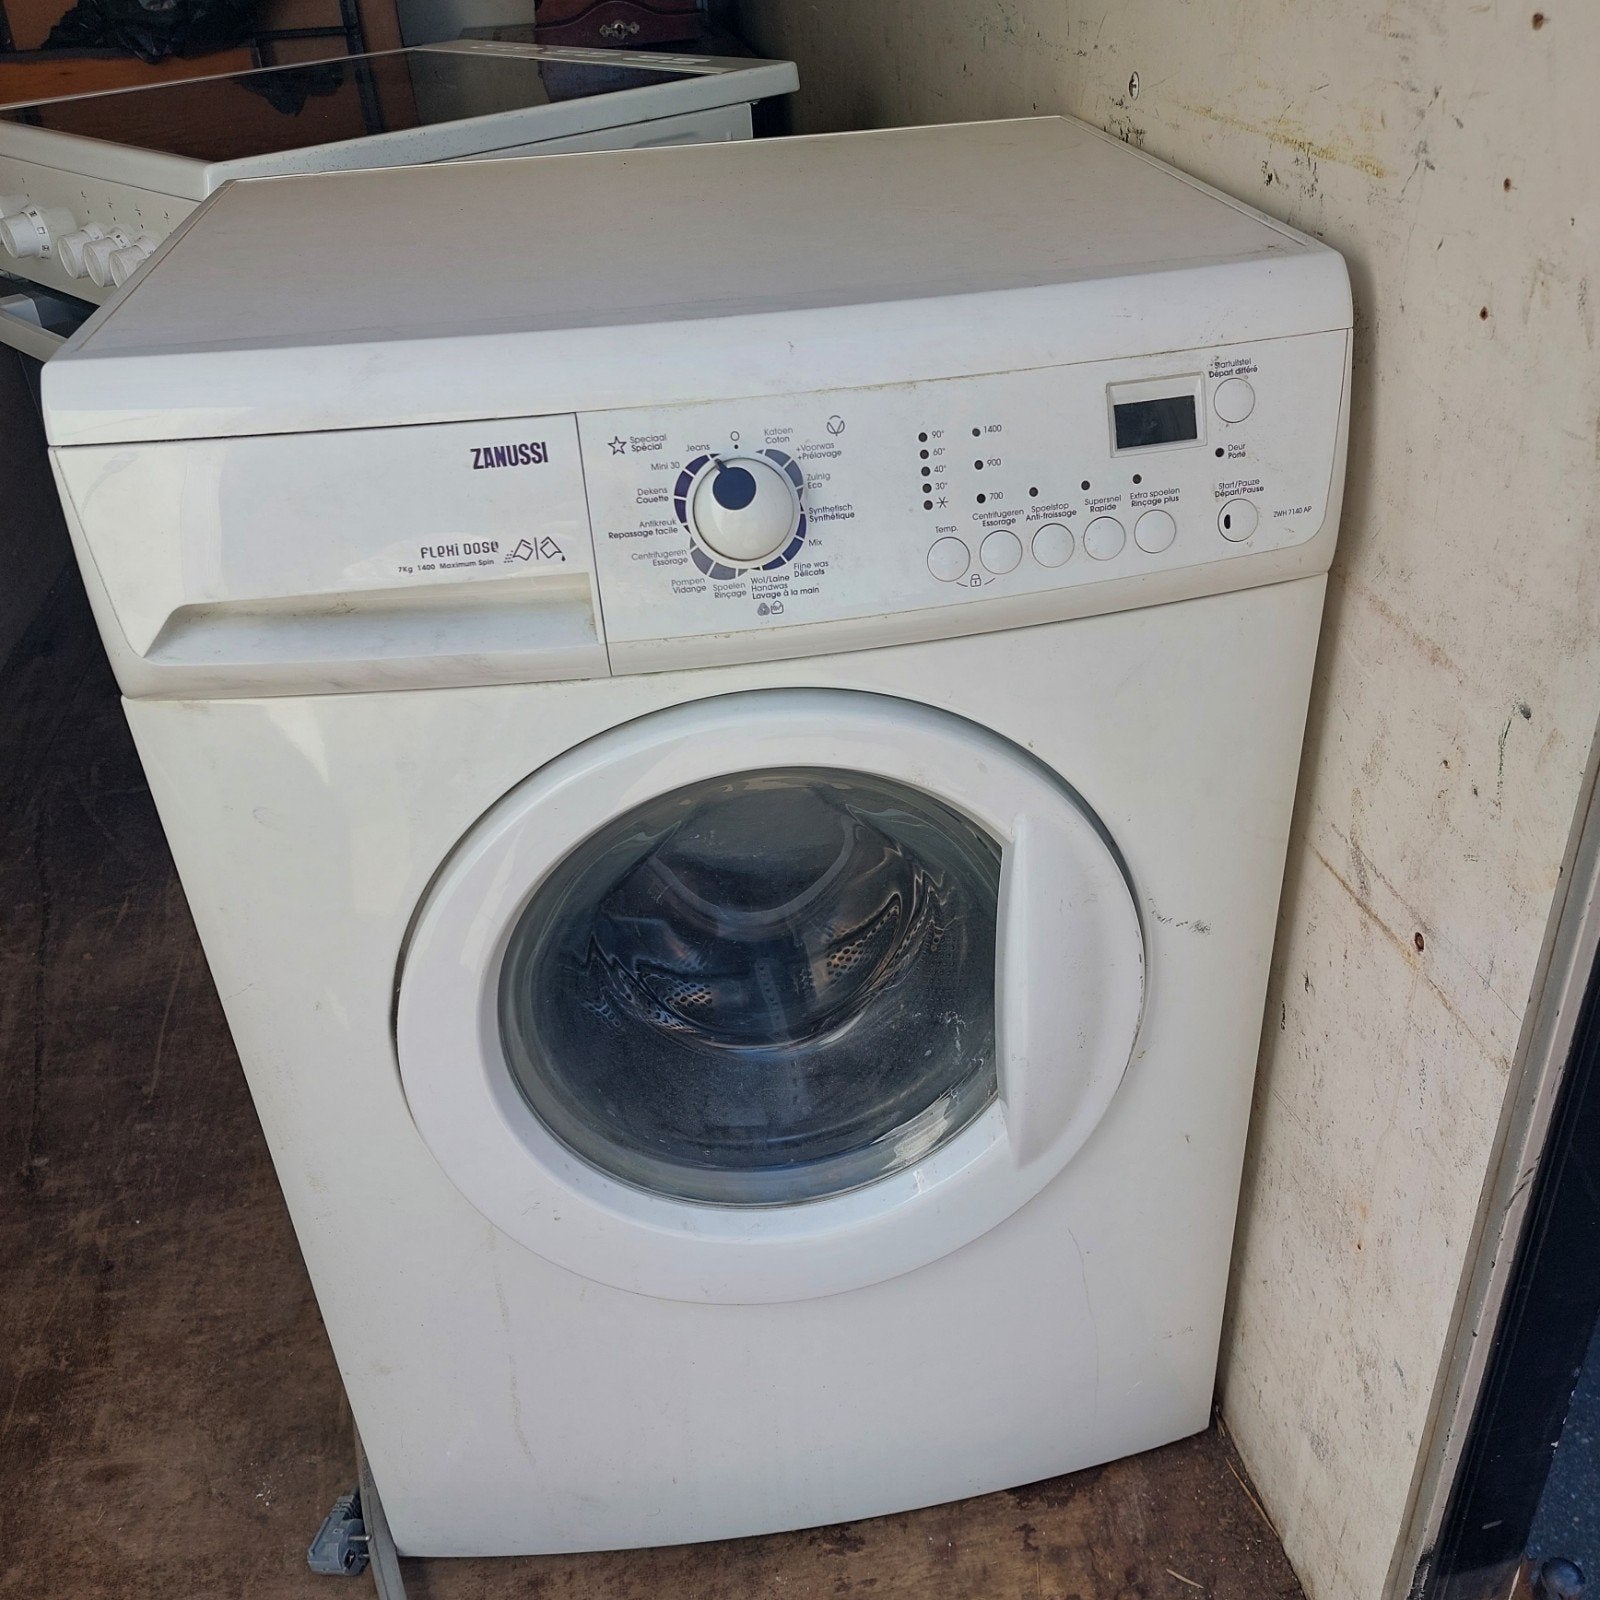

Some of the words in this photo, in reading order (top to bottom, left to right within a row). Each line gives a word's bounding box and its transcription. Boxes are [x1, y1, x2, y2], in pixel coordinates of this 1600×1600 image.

[1208, 368, 1233, 378] Départ
[1235, 366, 1258, 374] différé
[764, 427, 794, 436] Katoen
[984, 424, 1002, 434] 1400
[630, 434, 667, 444] Speciaal
[766, 436, 790, 444] Coton
[631, 443, 662, 452] Spécial
[686, 444, 710, 452] Jeans
[1228, 444, 1246, 452] Deur
[470, 442, 548, 470] ZANUSSI
[1228, 451, 1246, 459] Porte
[650, 462, 668, 471] Mini
[670, 462, 680, 470] 30
[986, 458, 1002, 466] 900
[806, 472, 830, 481] Zuinig
[1218, 478, 1260, 490] Start/Pauze
[637, 488, 668, 496] Dekens
[990, 492, 1004, 500] 700
[1130, 492, 1148, 500] Extra
[1150, 487, 1180, 498] spoelen
[1215, 486, 1264, 498] Départ/Pause
[636, 496, 669, 504] Couette
[1084, 494, 1122, 506] Supersnel
[1131, 498, 1161, 508] Rinçage
[1164, 496, 1180, 504] plus
[808, 504, 853, 516] Synthetisch
[1032, 502, 1069, 513] Spoelstop
[1090, 504, 1116, 514] Rapide
[1274, 508, 1288, 518] ZWH
[1288, 507, 1303, 516] 7140
[1304, 506, 1312, 514] AP
[809, 512, 855, 522] Synthétique
[972, 508, 1024, 520] Centrifugeren
[1026, 508, 1077, 522] Anti-froissage
[640, 519, 677, 528] Antikreuk
[982, 517, 1016, 528] Essorage
[608, 530, 654, 540] Repassage
[656, 527, 678, 536] facile
[935, 525, 958, 534] Temp.
[632, 549, 687, 560] Centrifugeren
[440, 560, 476, 570] Maximum
[478, 558, 494, 568] Spin
[653, 557, 688, 566] Essorage
[794, 562, 812, 571] Fijne
[794, 568, 825, 578] Délicats
[672, 578, 706, 588] Pompen
[750, 575, 790, 584] Wol/Laine
[672, 585, 706, 594] Vidange
[713, 582, 746, 592] Spoelen
[752, 583, 788, 592] Handwas
[715, 590, 746, 599] Rinçage
[752, 590, 782, 600] Lavage
[790, 588, 798, 596] la
[800, 586, 820, 595] main
